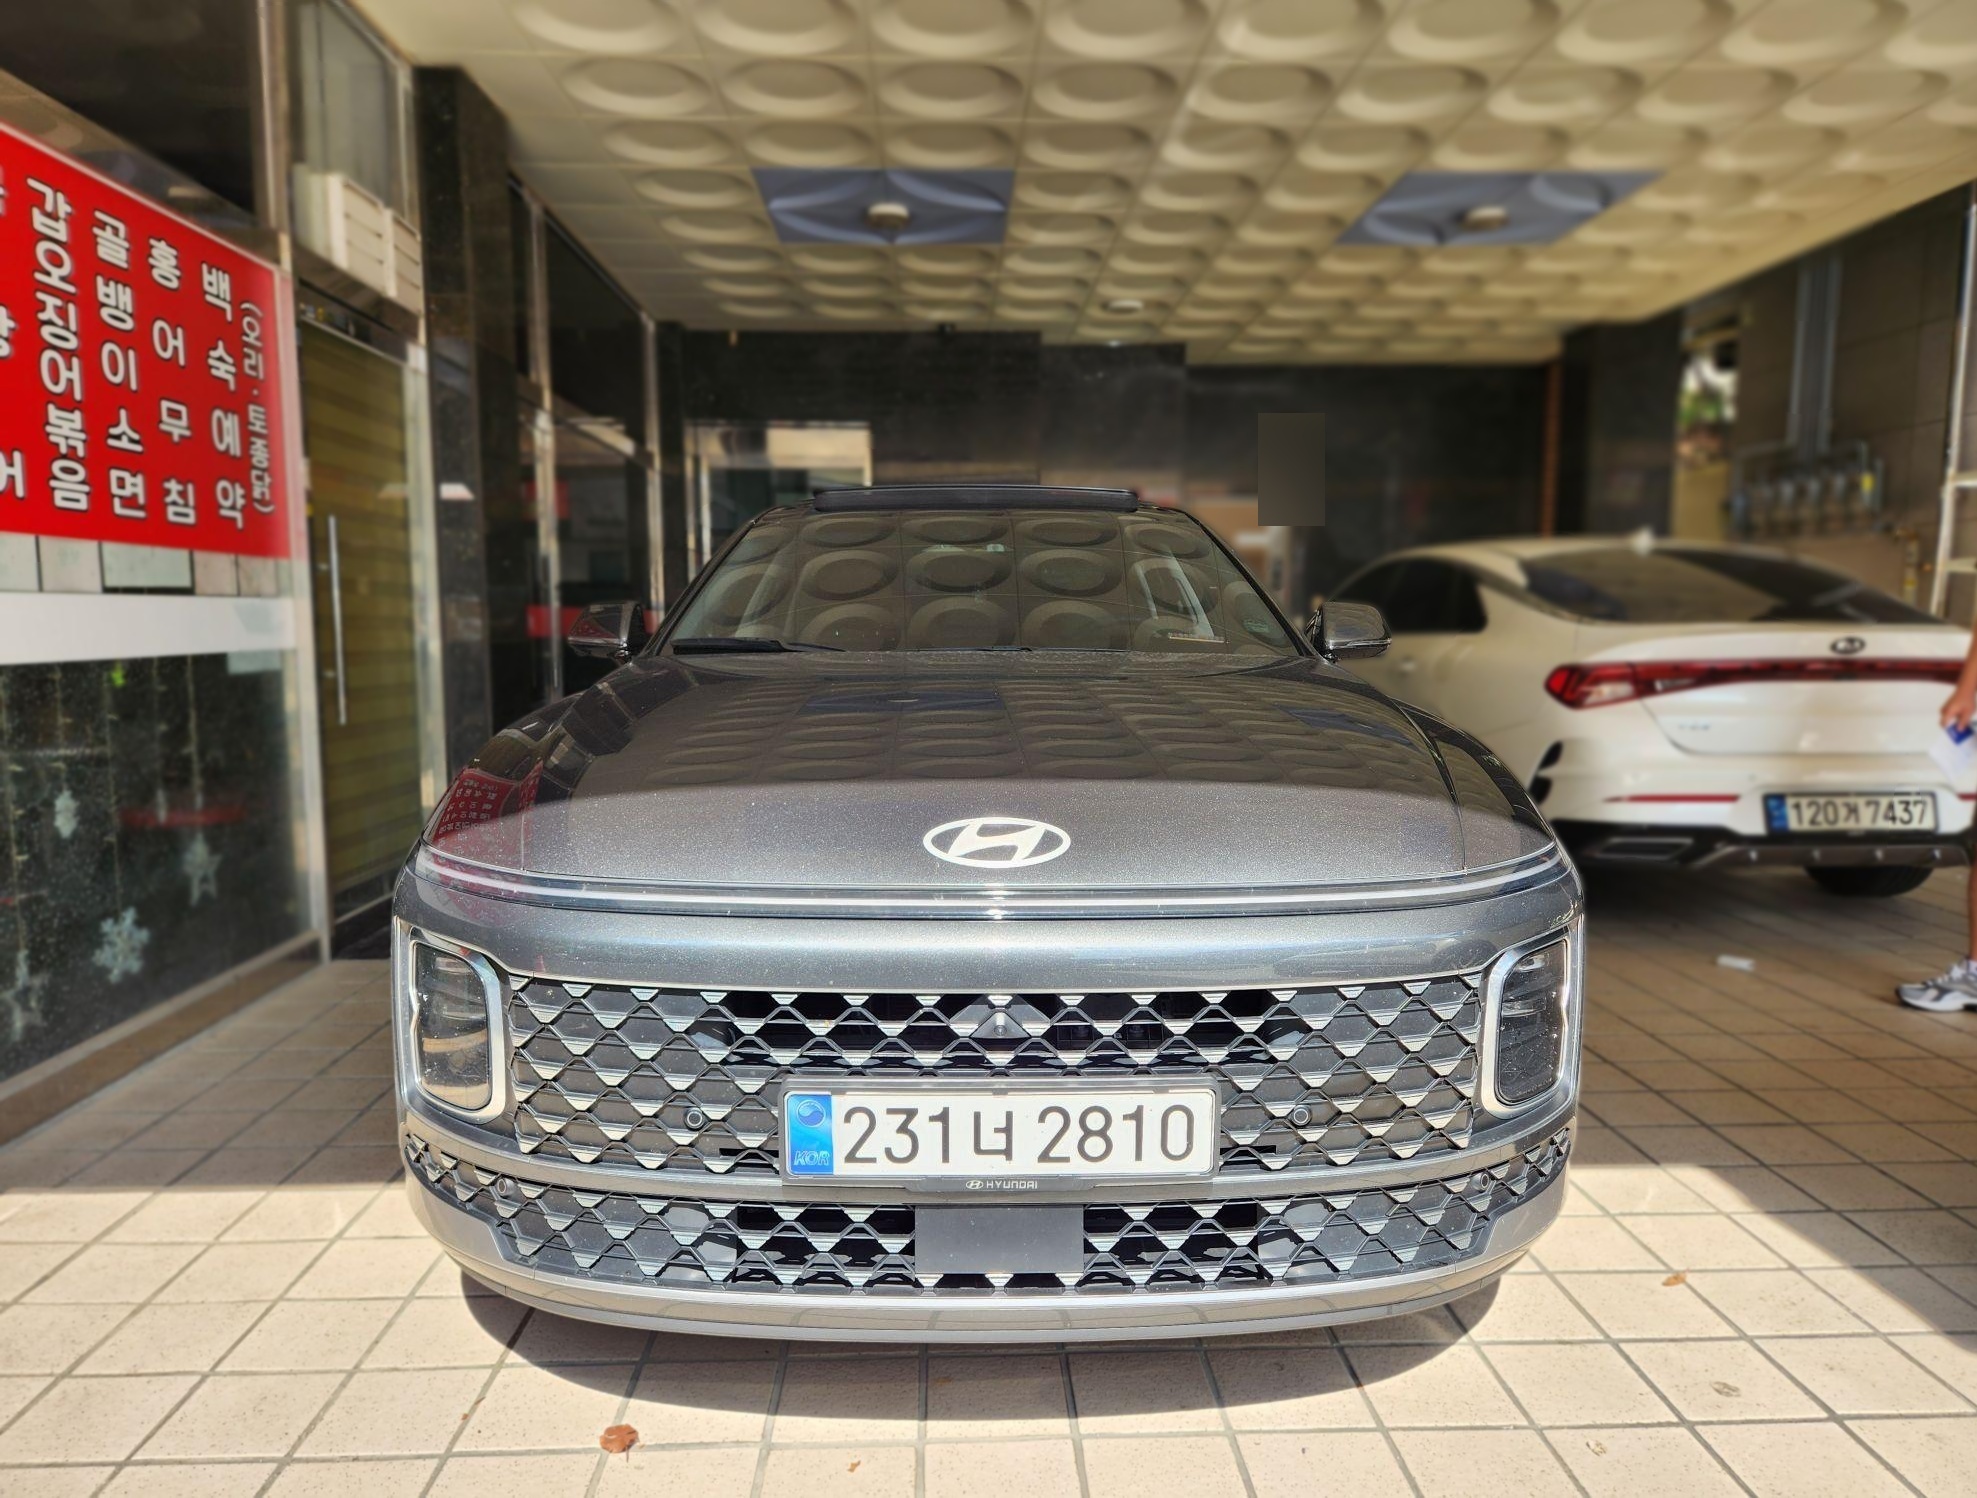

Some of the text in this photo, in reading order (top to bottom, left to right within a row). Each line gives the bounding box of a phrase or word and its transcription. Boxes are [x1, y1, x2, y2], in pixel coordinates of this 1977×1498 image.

[27, 177, 91, 512] 갑오징어볶음
[92, 209, 147, 518] 골뱅이소면
[794, 1149, 830, 1166] KOR
[1036, 1103, 1195, 1163] 2810
[985, 1179, 1038, 1190] HYUNDAI
